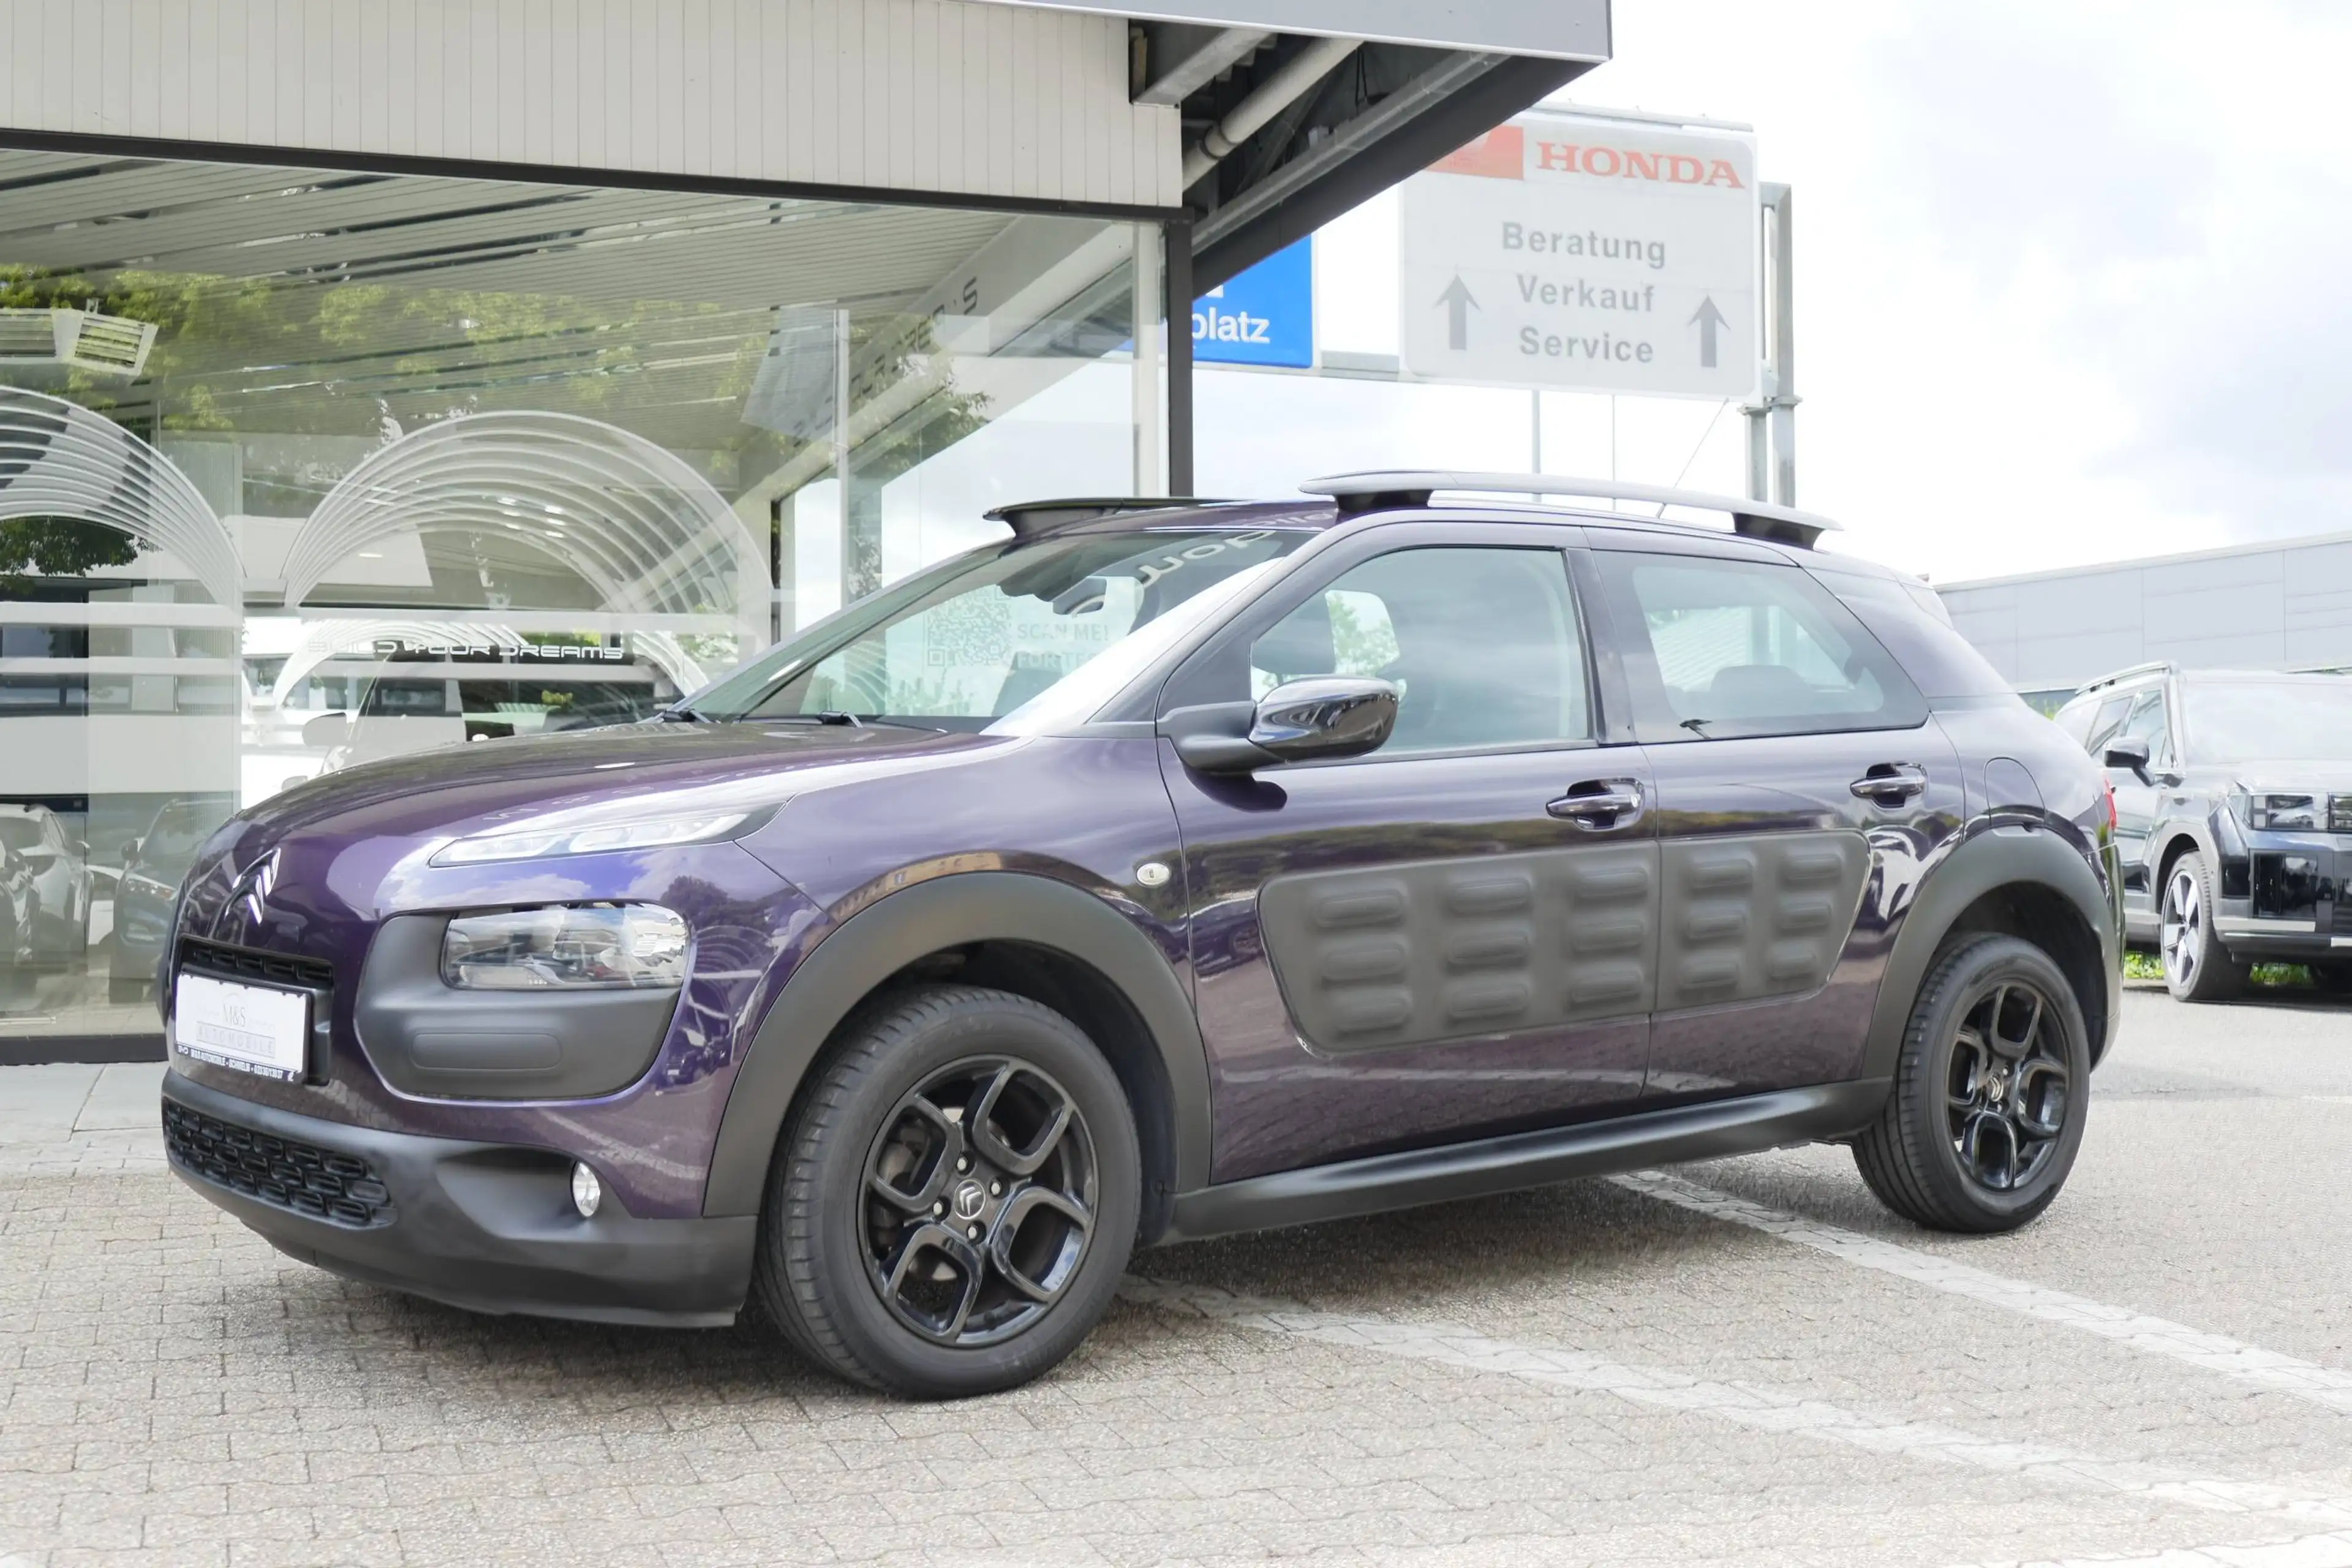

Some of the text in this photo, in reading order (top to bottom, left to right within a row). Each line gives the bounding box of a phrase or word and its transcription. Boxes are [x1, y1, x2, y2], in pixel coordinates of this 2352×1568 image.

[1536, 141, 1746, 190] HONDA
[1501, 221, 1666, 270] Beratung
[1517, 274, 1655, 313] Verkauf
[1519, 326, 1654, 364] Service
[1017, 622, 1109, 641] SCAN ME!
[408, 643, 491, 656] YOUR
[499, 645, 624, 660] DREAMS
[222, 1003, 246, 1028] M&S
